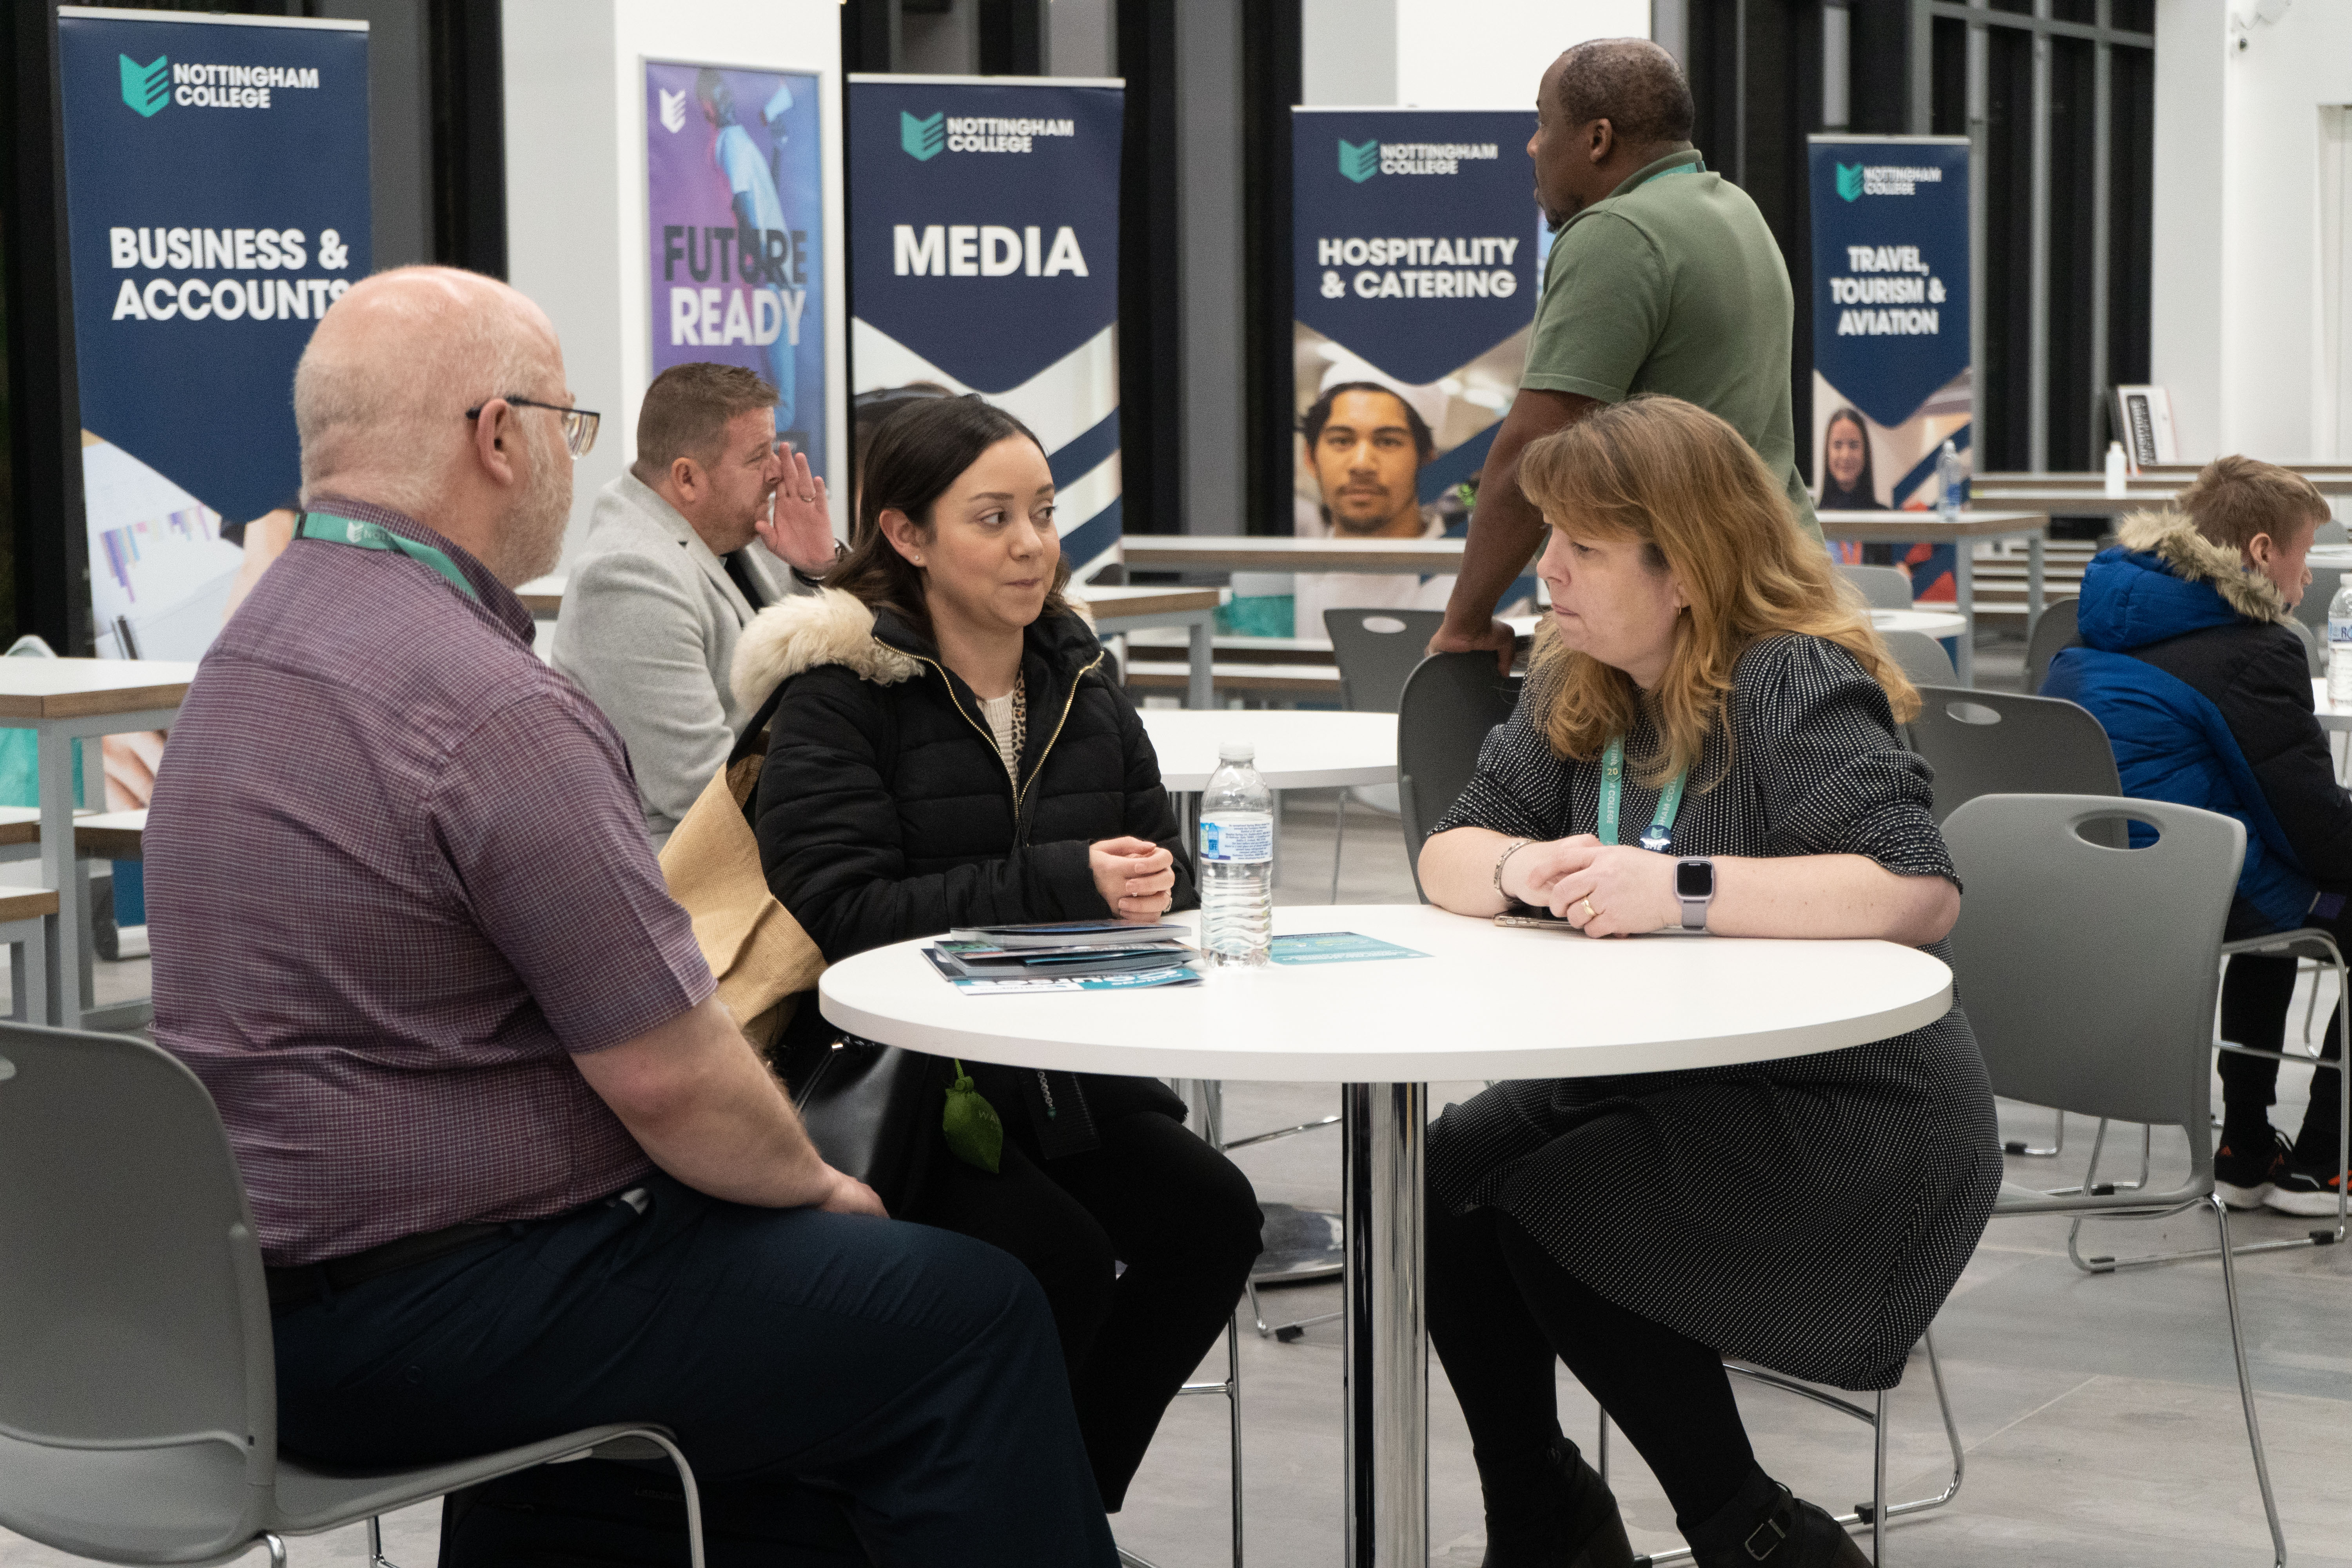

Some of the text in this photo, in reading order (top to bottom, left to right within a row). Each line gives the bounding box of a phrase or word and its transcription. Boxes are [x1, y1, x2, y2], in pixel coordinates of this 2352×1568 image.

[174, 64, 319, 89] NOTTINGHAM
[175, 86, 270, 109] COLLEGE
[947, 117, 1074, 138] NOTTINGHAM
[947, 134, 1033, 153] COLLEGE
[1380, 143, 1498, 160] NOTTINGHAM
[1380, 159, 1458, 175] COLLEGE
[1864, 166, 1942, 182] NOTTINGHAM
[1864, 182, 1915, 195] COLLEGE
[110, 227, 348, 270] BUSINESS &
[664, 225, 807, 285] FUTURE
[893, 225, 1089, 277] MEDIA
[1318, 238, 1519, 266] HOSPITALITY
[1847, 247, 1929, 276] TRAVEL,
[1321, 270, 1518, 298] & CATERING
[1830, 277, 1946, 304] TOURISM &
[670, 287, 806, 345] READY
[1838, 310, 1939, 336] AVIATION
[1606, 789, 1615, 824] COLLEGE
